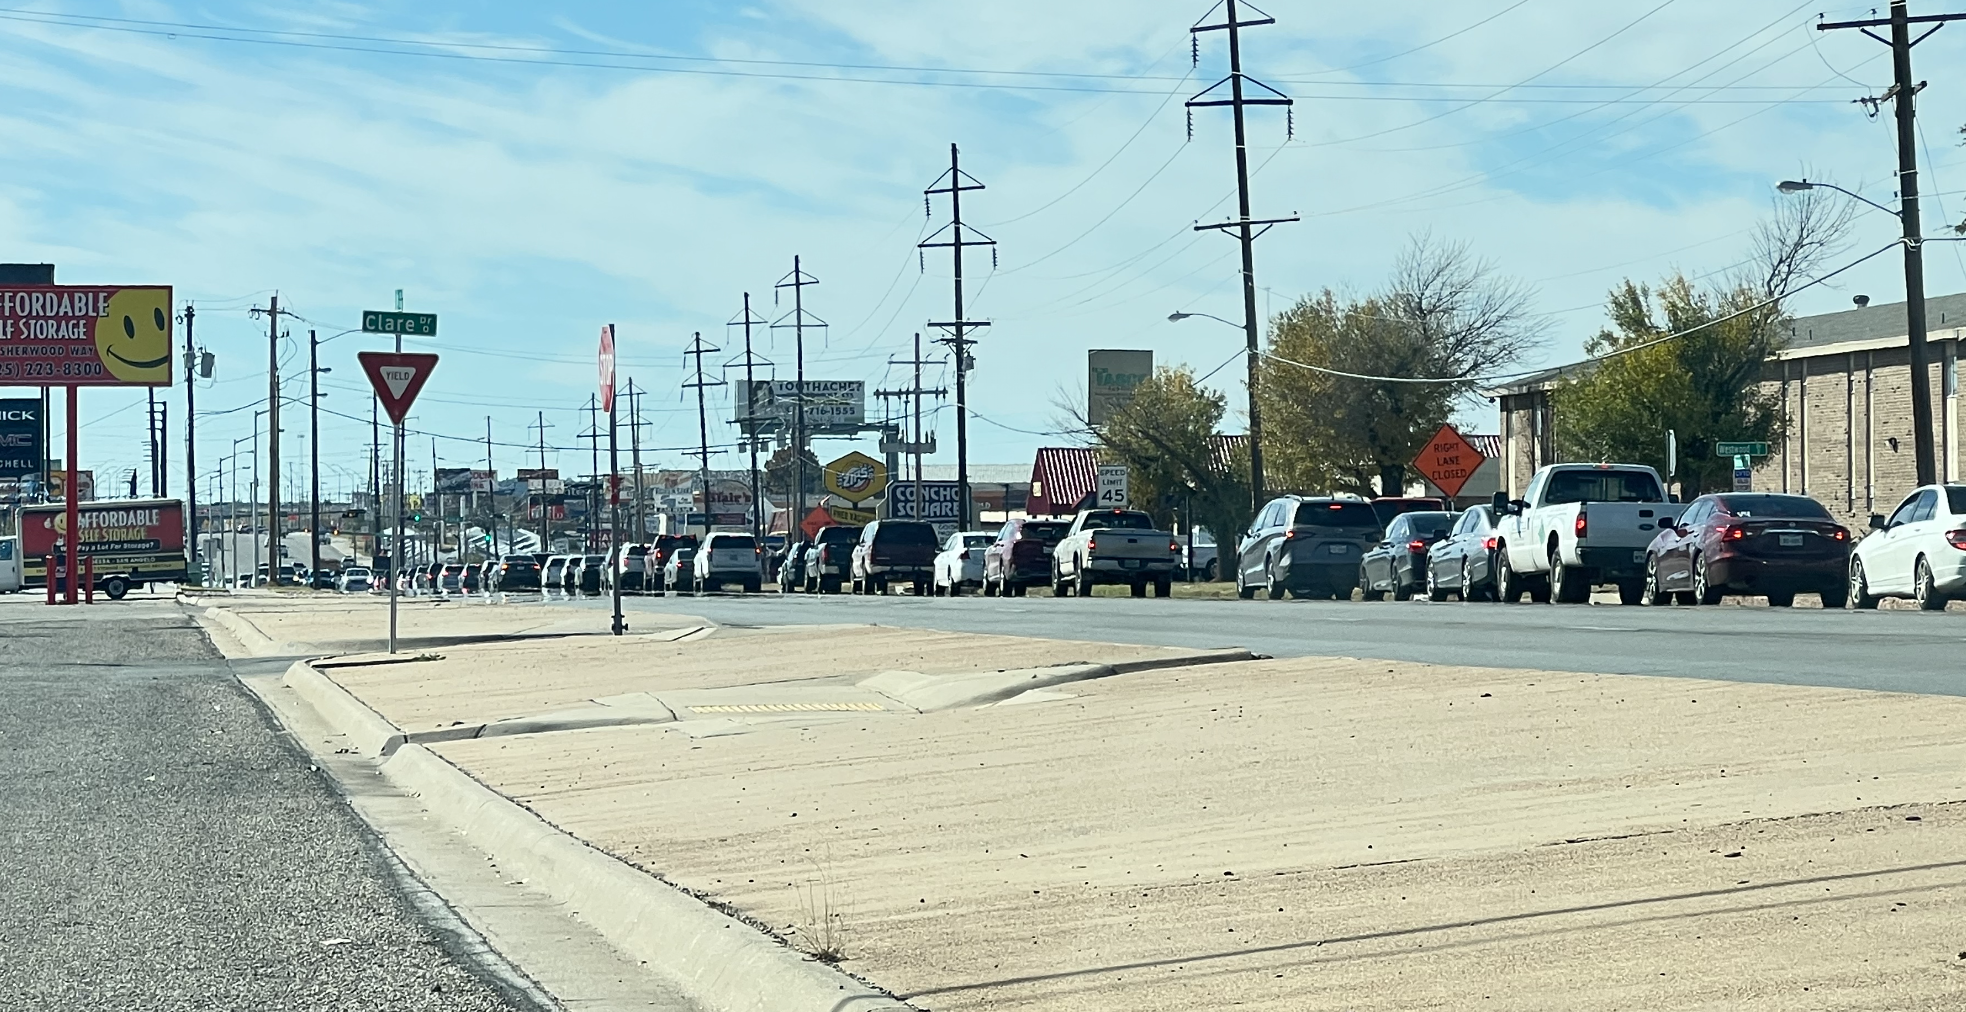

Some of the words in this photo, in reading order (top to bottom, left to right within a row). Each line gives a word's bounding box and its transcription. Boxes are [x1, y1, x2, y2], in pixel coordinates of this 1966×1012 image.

[0, 292, 109, 317] FORDABLE
[19, 318, 87, 339] STORAGE
[365, 314, 415, 332] Clare
[0, 346, 65, 356] SHERWOOD
[70, 346, 95, 356] WAY
[25, 362, 102, 376] 223-8300
[386, 371, 410, 381] YIELD
[0, 410, 36, 421] ICK
[1433, 442, 1460, 453] RIGHT
[1719, 445, 1750, 455] Westwood
[1436, 456, 1461, 467] LANE
[1431, 468, 1468, 481] CLOSED
[1102, 478, 1123, 486] LIMIT
[896, 486, 960, 501] CONCHO
[1101, 489, 1125, 502] 45
[897, 502, 960, 517] SQUARE
[77, 509, 160, 529] AFFORDABLE
[78, 529, 100, 542] SELF
[102, 526, 148, 542] STORAGE
